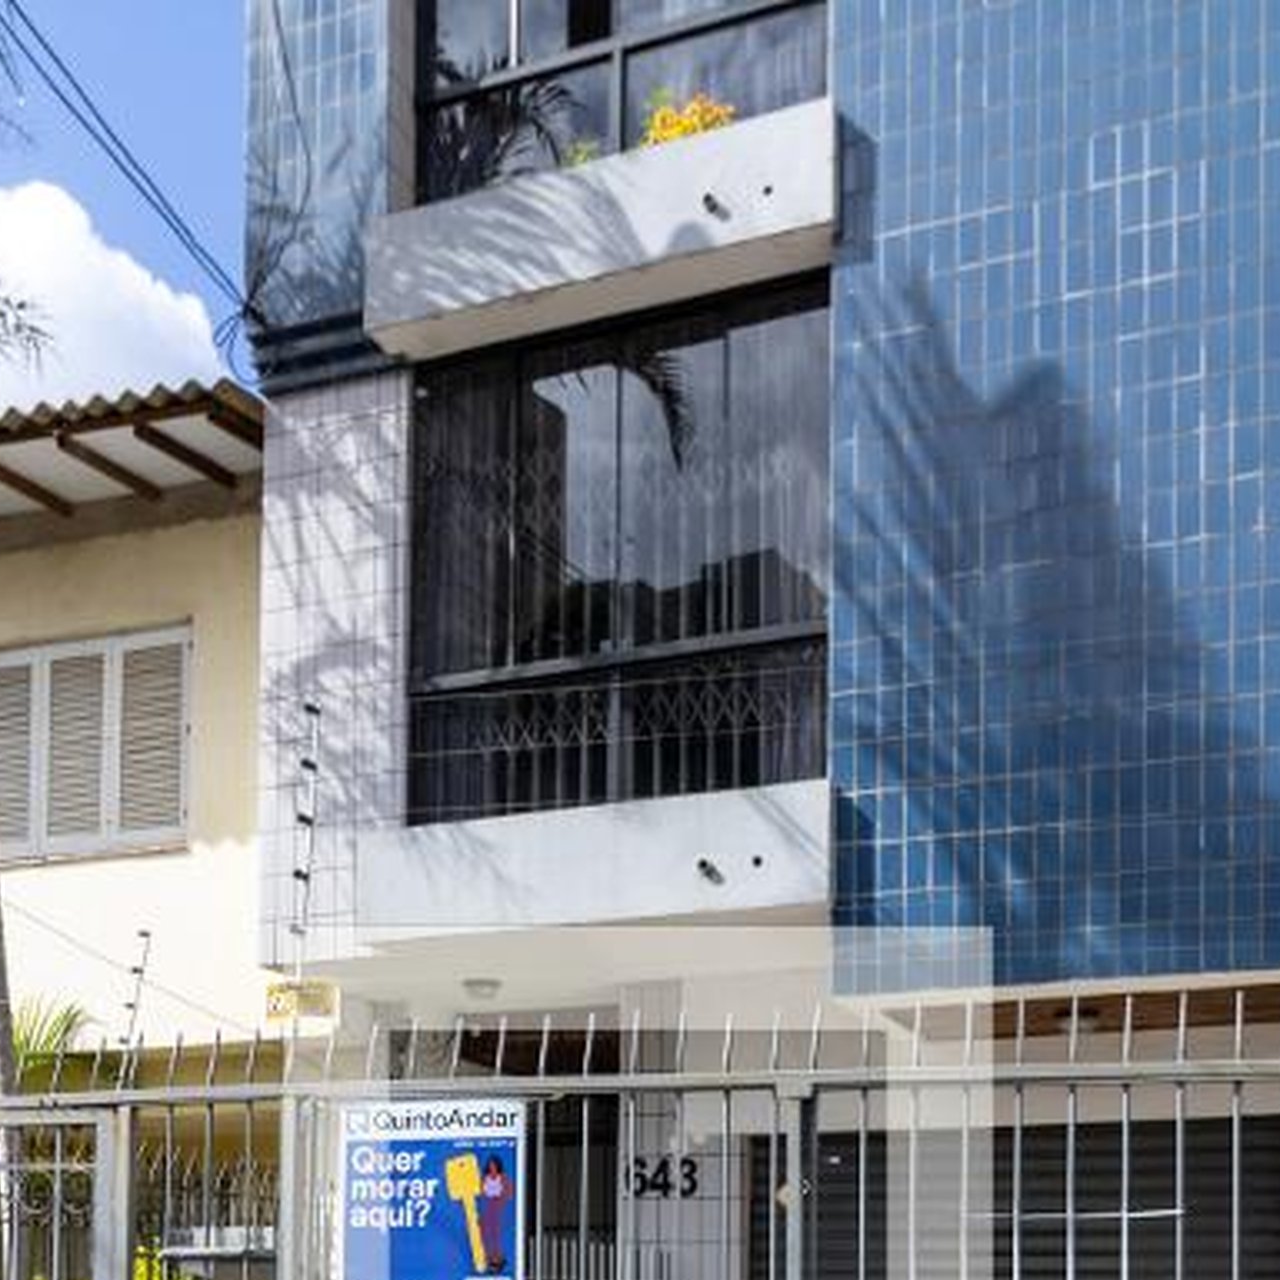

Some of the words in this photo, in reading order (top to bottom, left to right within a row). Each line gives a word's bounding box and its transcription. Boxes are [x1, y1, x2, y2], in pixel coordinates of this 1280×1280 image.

[373, 1107, 518, 1131] QuintoAndar
[351, 1145, 425, 1173] Quer
[351, 1177, 439, 1199] morar
[624, 1156, 698, 1198] 643
